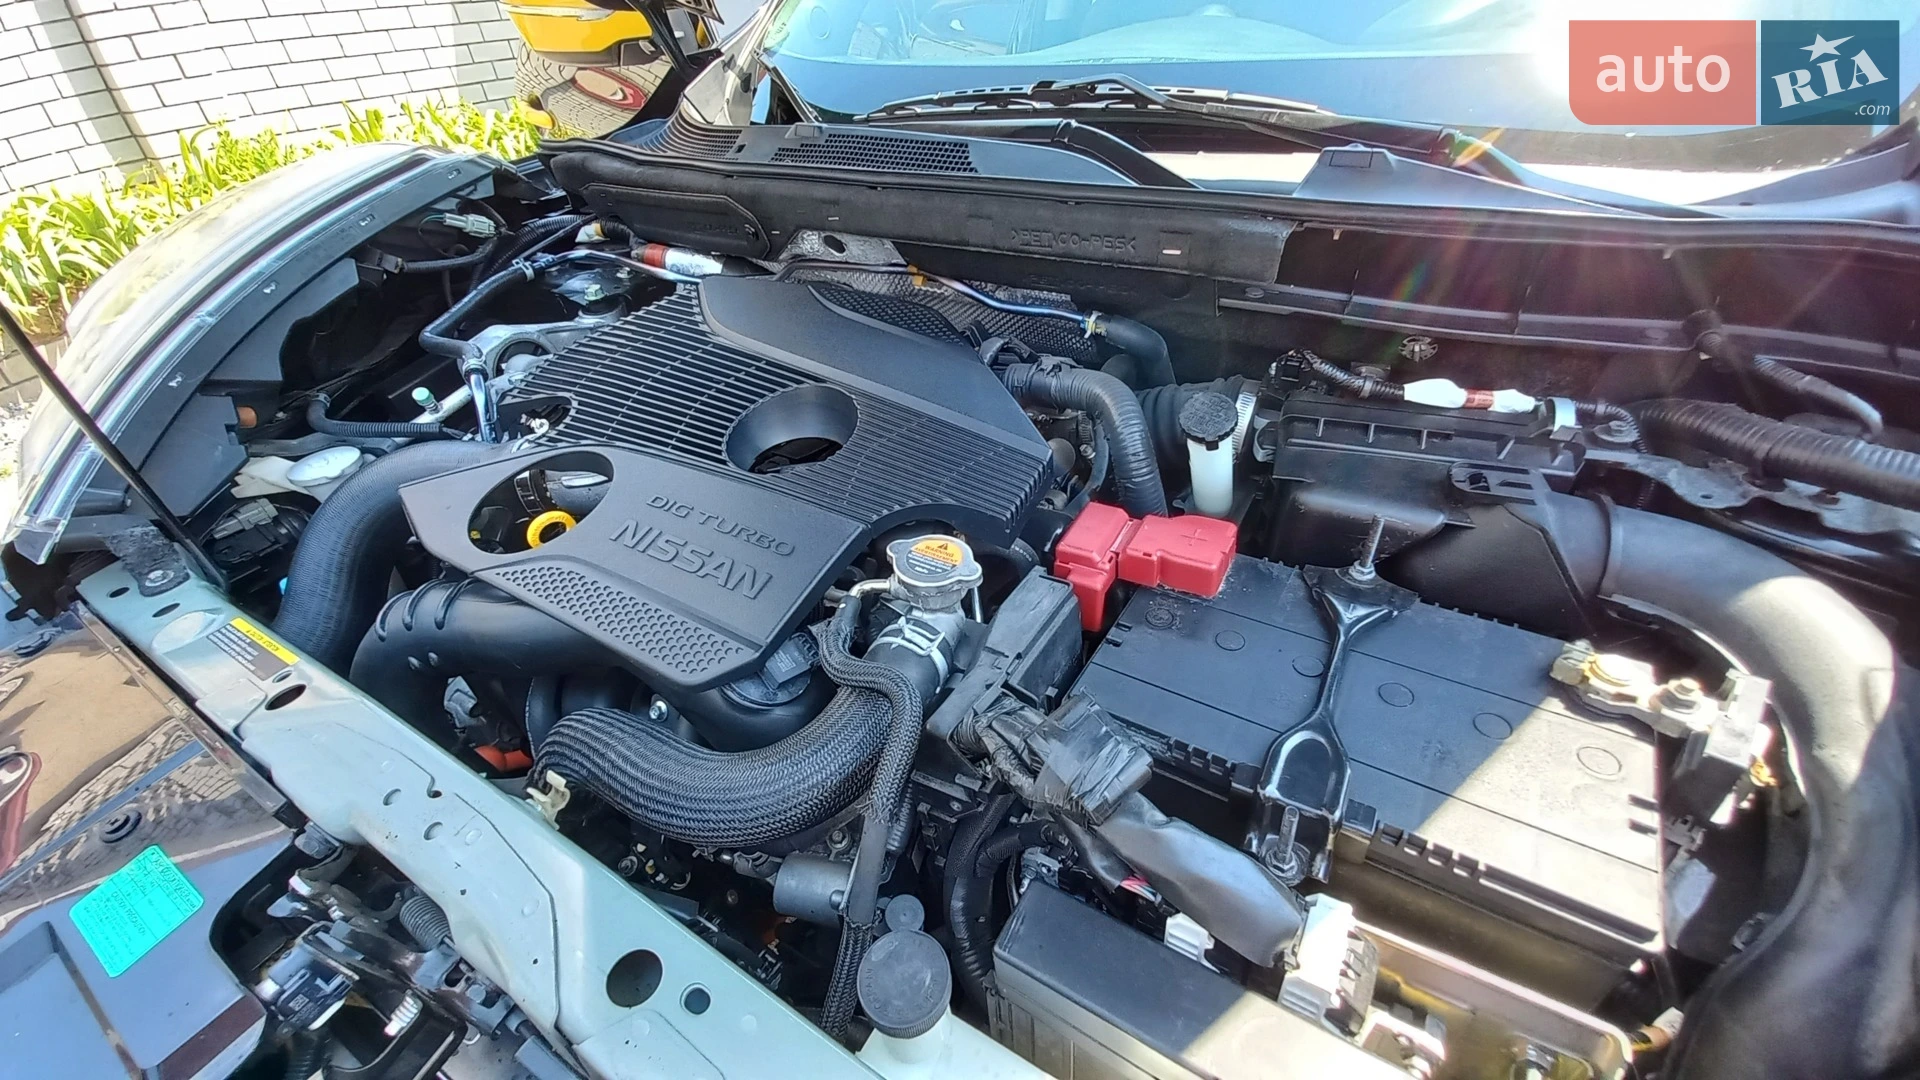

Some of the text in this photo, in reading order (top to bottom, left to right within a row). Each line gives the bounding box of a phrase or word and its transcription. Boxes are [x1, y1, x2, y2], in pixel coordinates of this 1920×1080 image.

[609, 518, 773, 600] NISSAN
[646, 494, 796, 557] DIG TURBO
